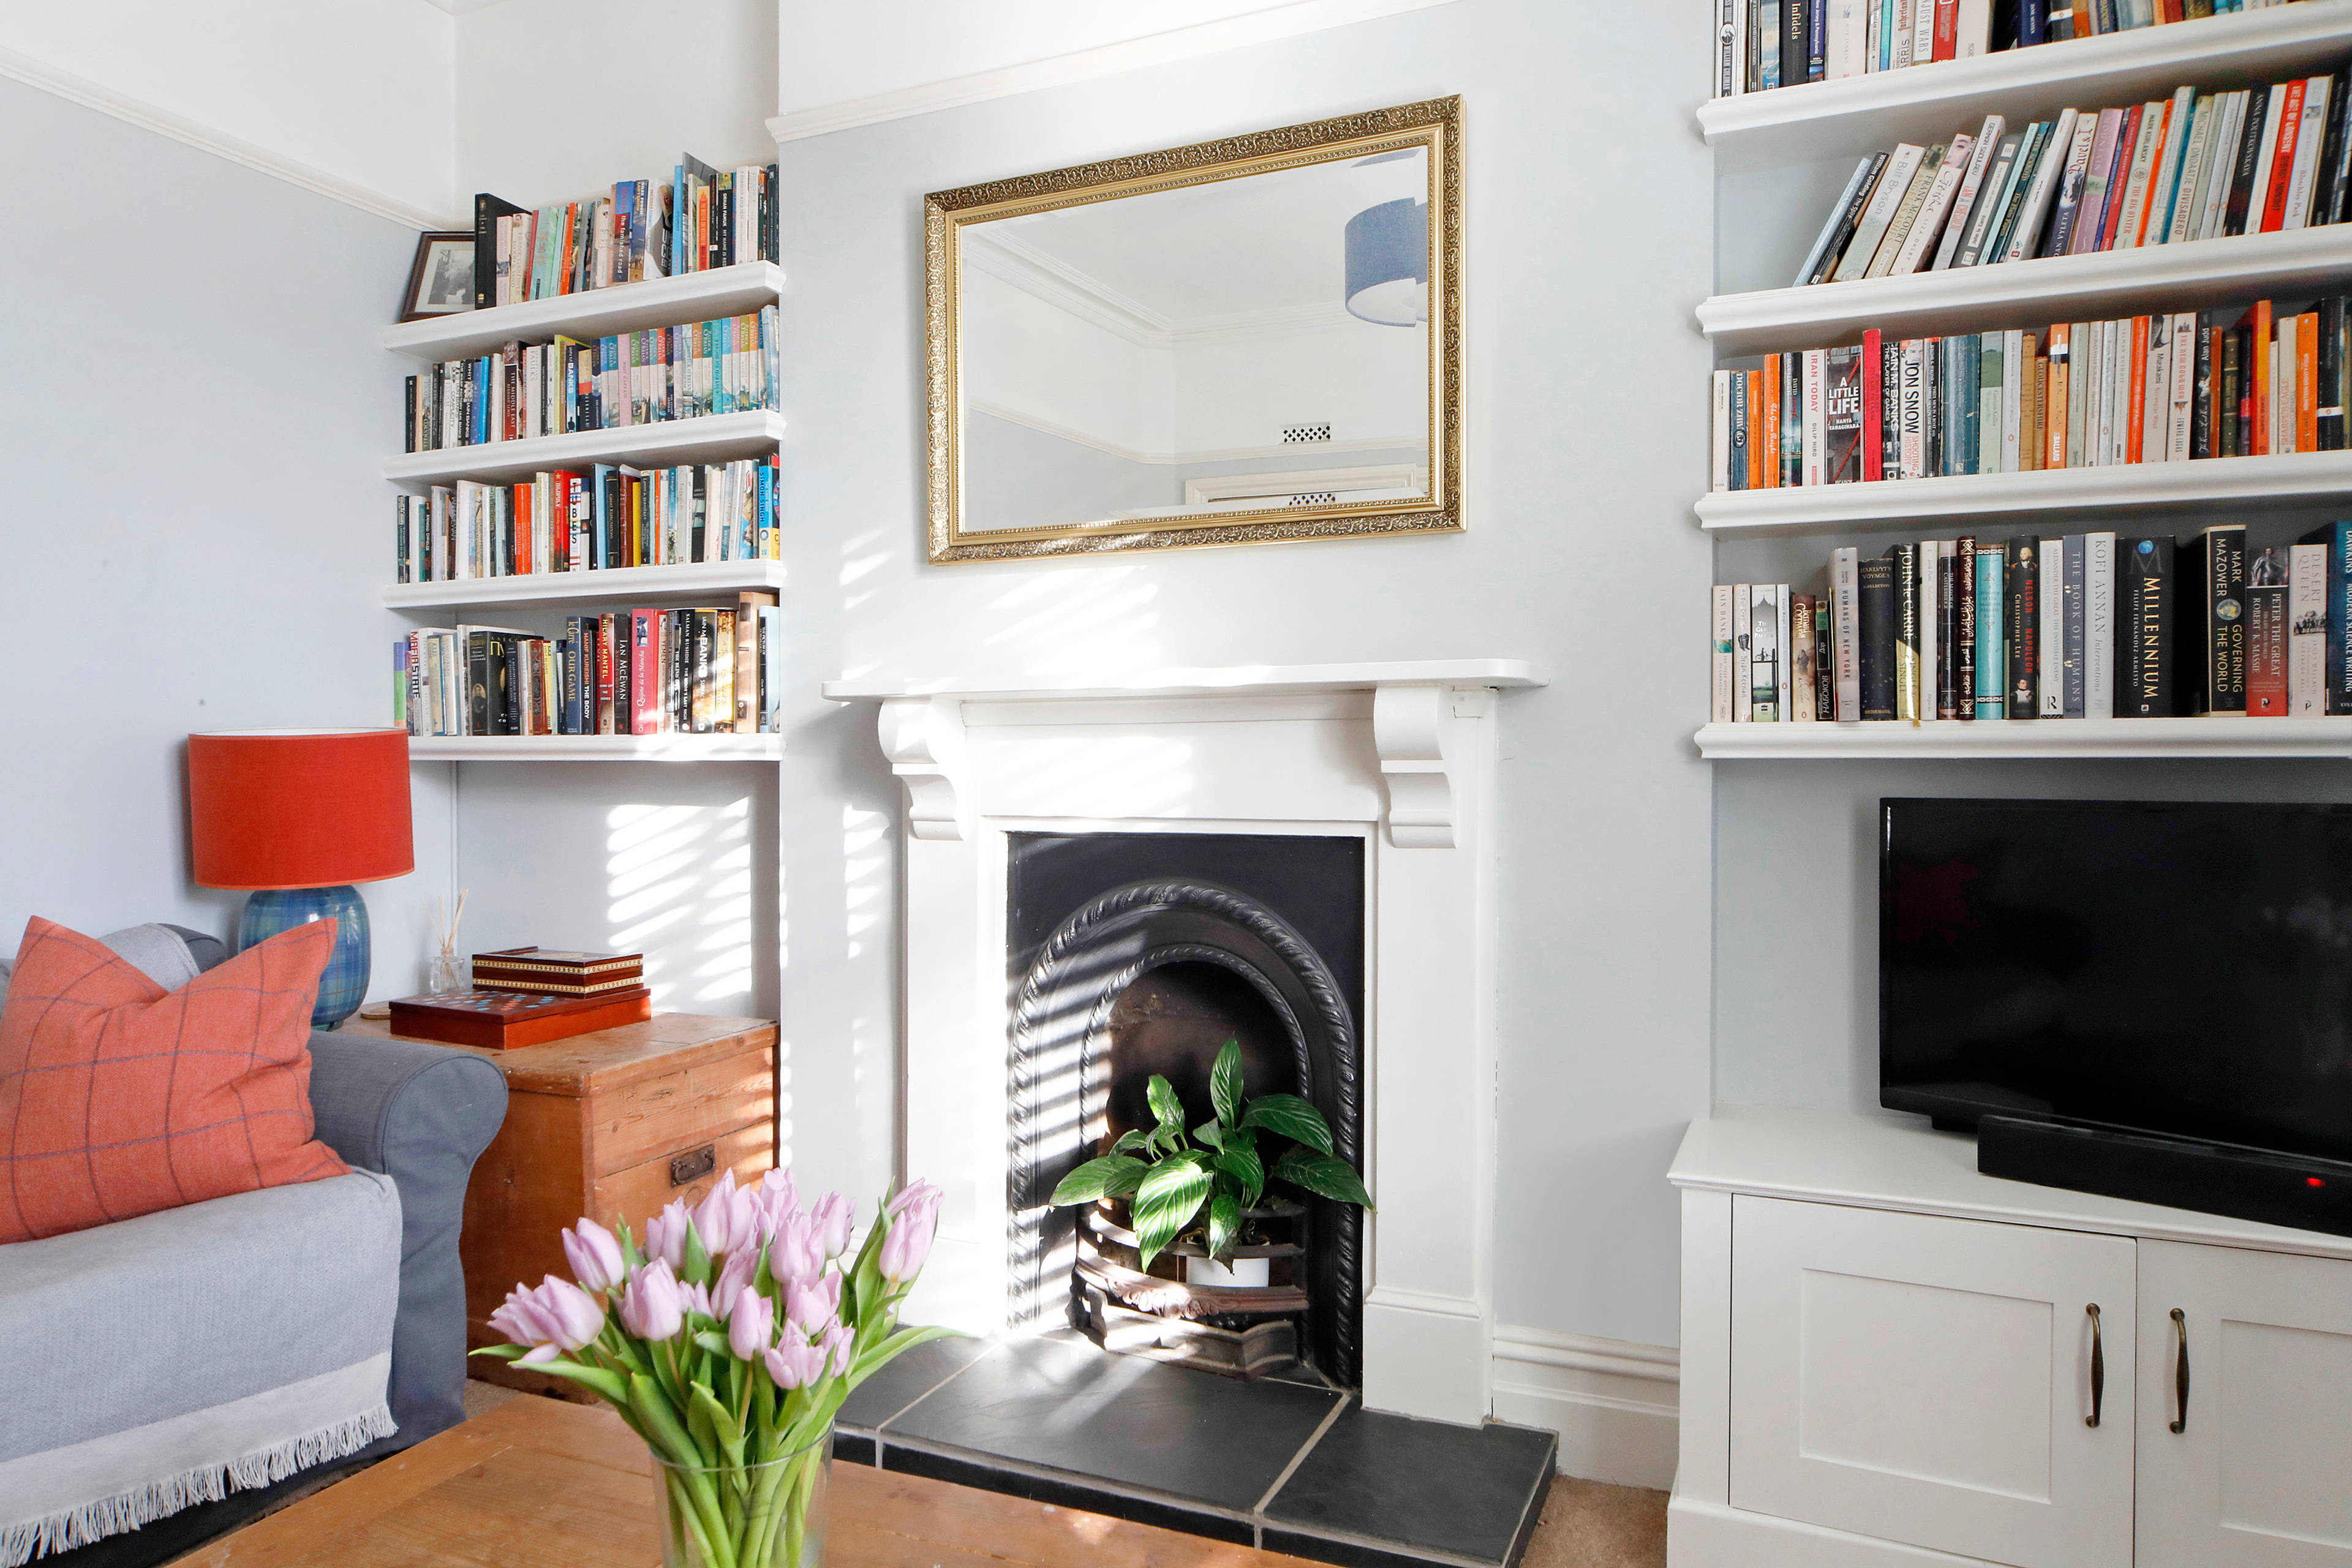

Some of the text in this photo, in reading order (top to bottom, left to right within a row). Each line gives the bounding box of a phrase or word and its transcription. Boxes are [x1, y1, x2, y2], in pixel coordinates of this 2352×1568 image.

[1792, 3, 1801, 40] Infidels
[1918, 29, 1930, 53] WARS
[1971, 123, 1996, 176] GERMAN SADULAEV
[2242, 94, 2264, 177] ANNA POLITKOVSKAYA
[1847, 153, 1887, 219] William Golding The Spire
[1874, 161, 1909, 215] Bill Bryson
[2123, 115, 2156, 234] MARK KURLANSKY THE BIG OYSTER
[2174, 111, 2209, 236] MICHAEL ONDAATJE DIVISADERO
[2293, 170, 2307, 217] Bletchley Park
[1894, 175, 1933, 245] FRANK McCOURT
[1905, 219, 1928, 261] LIZA DALBY
[1840, 377, 1848, 387] A
[1890, 374, 1898, 386] M.
[1905, 361, 1919, 388] JON
[2155, 353, 2164, 384] Murakami
[1829, 386, 1859, 399] LITTLE
[1829, 398, 1859, 415] LIFE
[1904, 391, 1919, 434] SNOW
[2037, 363, 2047, 429] GLOUCESTERSHIRE
[2175, 438, 2184, 453] LUCAS
[2176, 418, 2185, 437] EDWARD
[2095, 540, 2106, 573] KOFI
[2216, 538, 2226, 597] MAZOWER
[2232, 551, 2242, 582] MARK
[1899, 551, 1917, 640] JOHN le CARRÉ
[2025, 579, 2034, 613] NELSON
[2298, 555, 2309, 602] QUEEN
[2312, 554, 2321, 603] DESERT
[1794, 603, 1806, 638] Cornwell
[1803, 609, 1812, 633] Bernard
[2095, 580, 2106, 633] ANNAN
[567, 627, 579, 644] Carré
[2025, 628, 2034, 674] NAPOLEON
[2072, 625, 2080, 641] OF
[2144, 577, 2160, 698] MILLENNIUM
[2272, 594, 2281, 676] PETER THE GREAT
[410, 631, 420, 699] MAFIA STATE
[568, 650, 576, 673] OUR
[2217, 626, 2227, 692] THE WORLD
[2232, 625, 2242, 693] GOVERNING
[568, 674, 576, 702] GAME
